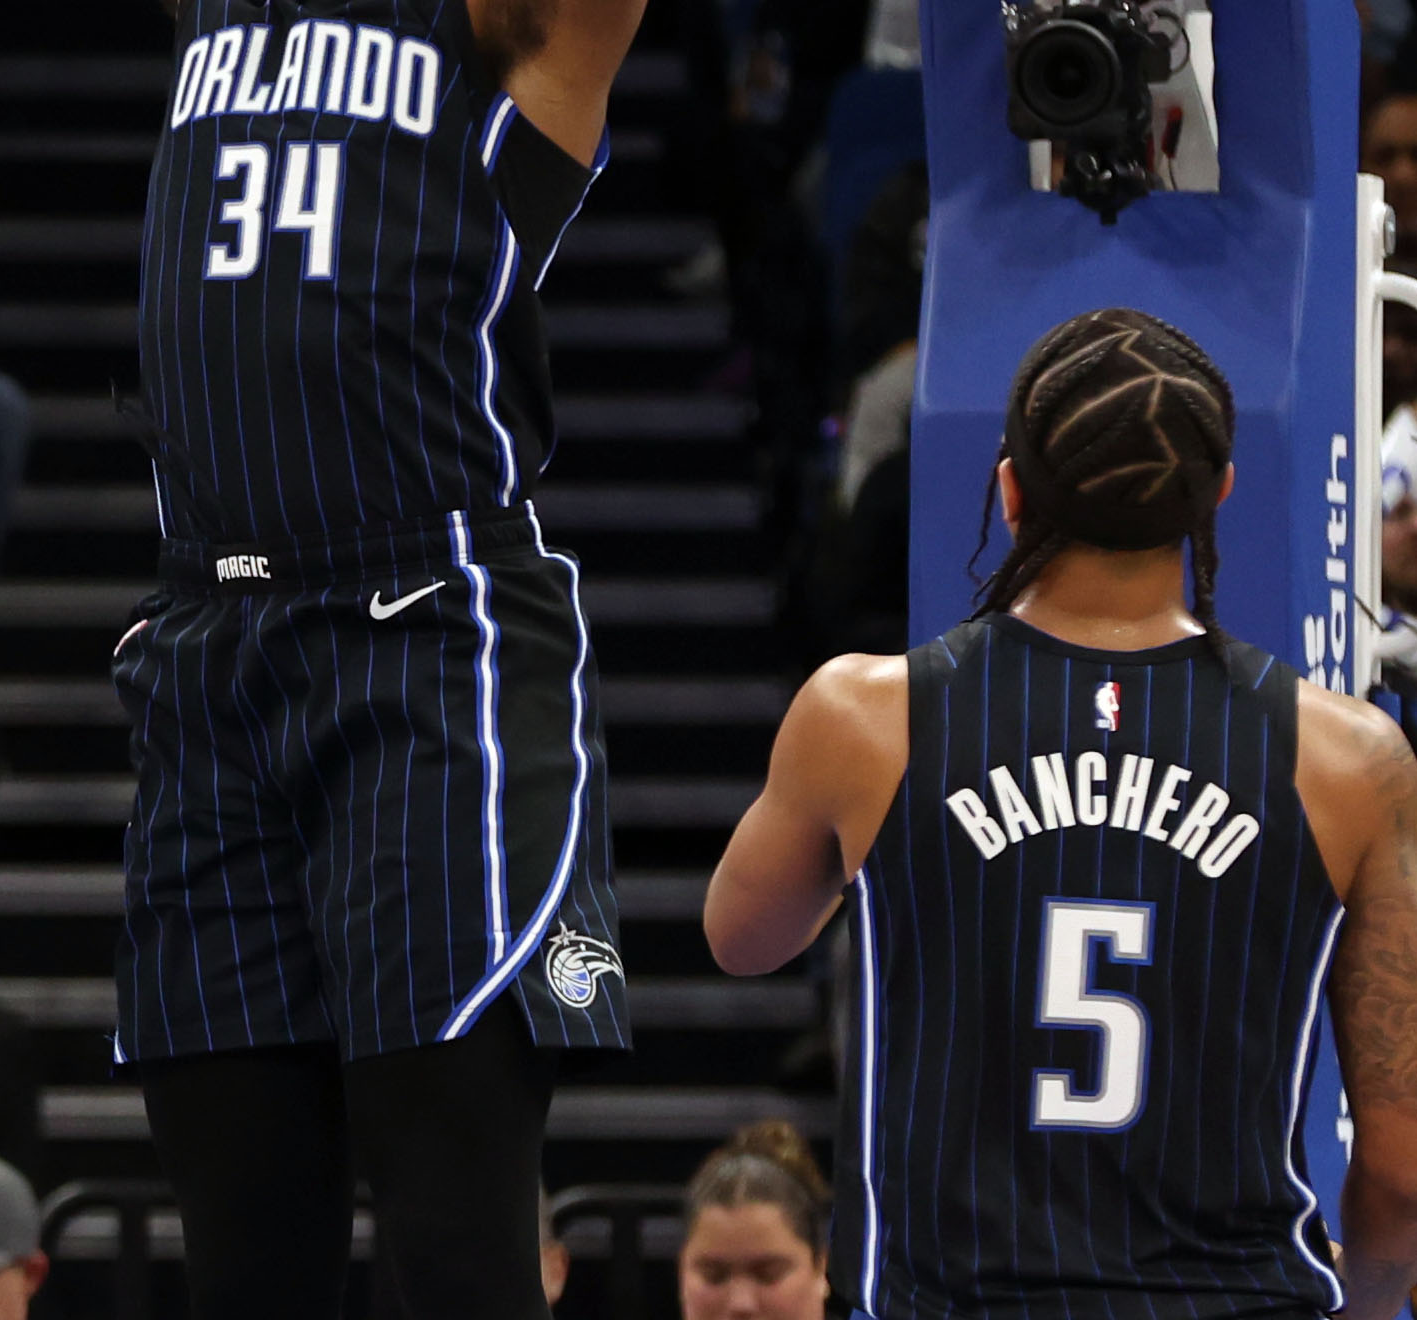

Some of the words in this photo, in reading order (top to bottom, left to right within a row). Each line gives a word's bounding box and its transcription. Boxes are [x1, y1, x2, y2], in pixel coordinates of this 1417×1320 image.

[171, 18, 443, 137] ORLANDO
[204, 140, 347, 280] 34
[216, 555, 272, 583] MAGIC
[946, 751, 1261, 879] BANCHERO
[1029, 895, 1158, 1134] 5
